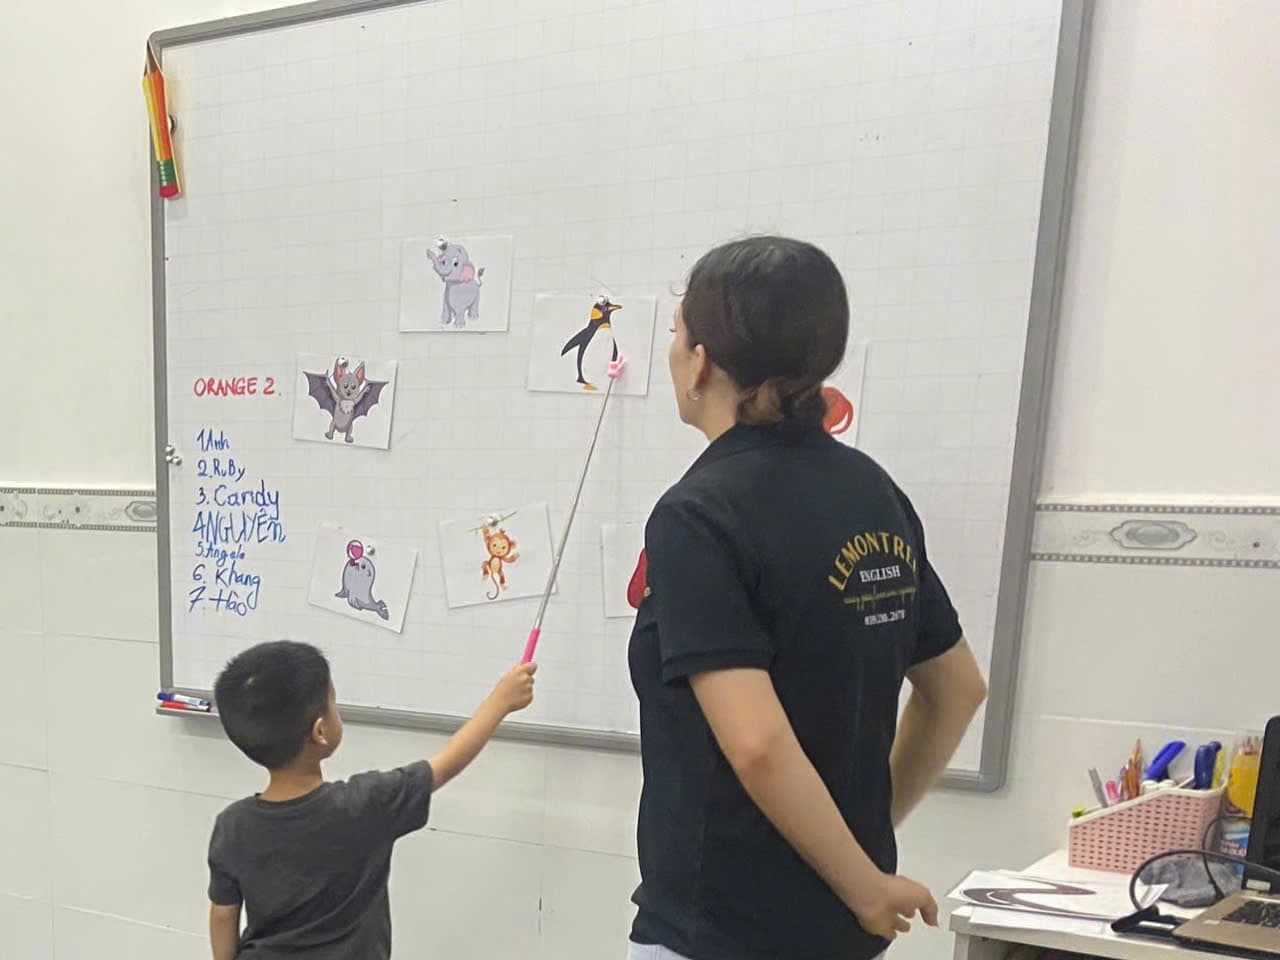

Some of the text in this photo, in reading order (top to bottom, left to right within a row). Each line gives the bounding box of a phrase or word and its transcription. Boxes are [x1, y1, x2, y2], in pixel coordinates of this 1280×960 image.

[194, 377, 258, 397] ORANGE
[214, 480, 279, 520] Candy
[215, 560, 261, 610] Khang
[859, 565, 901, 583] ENGLISH
